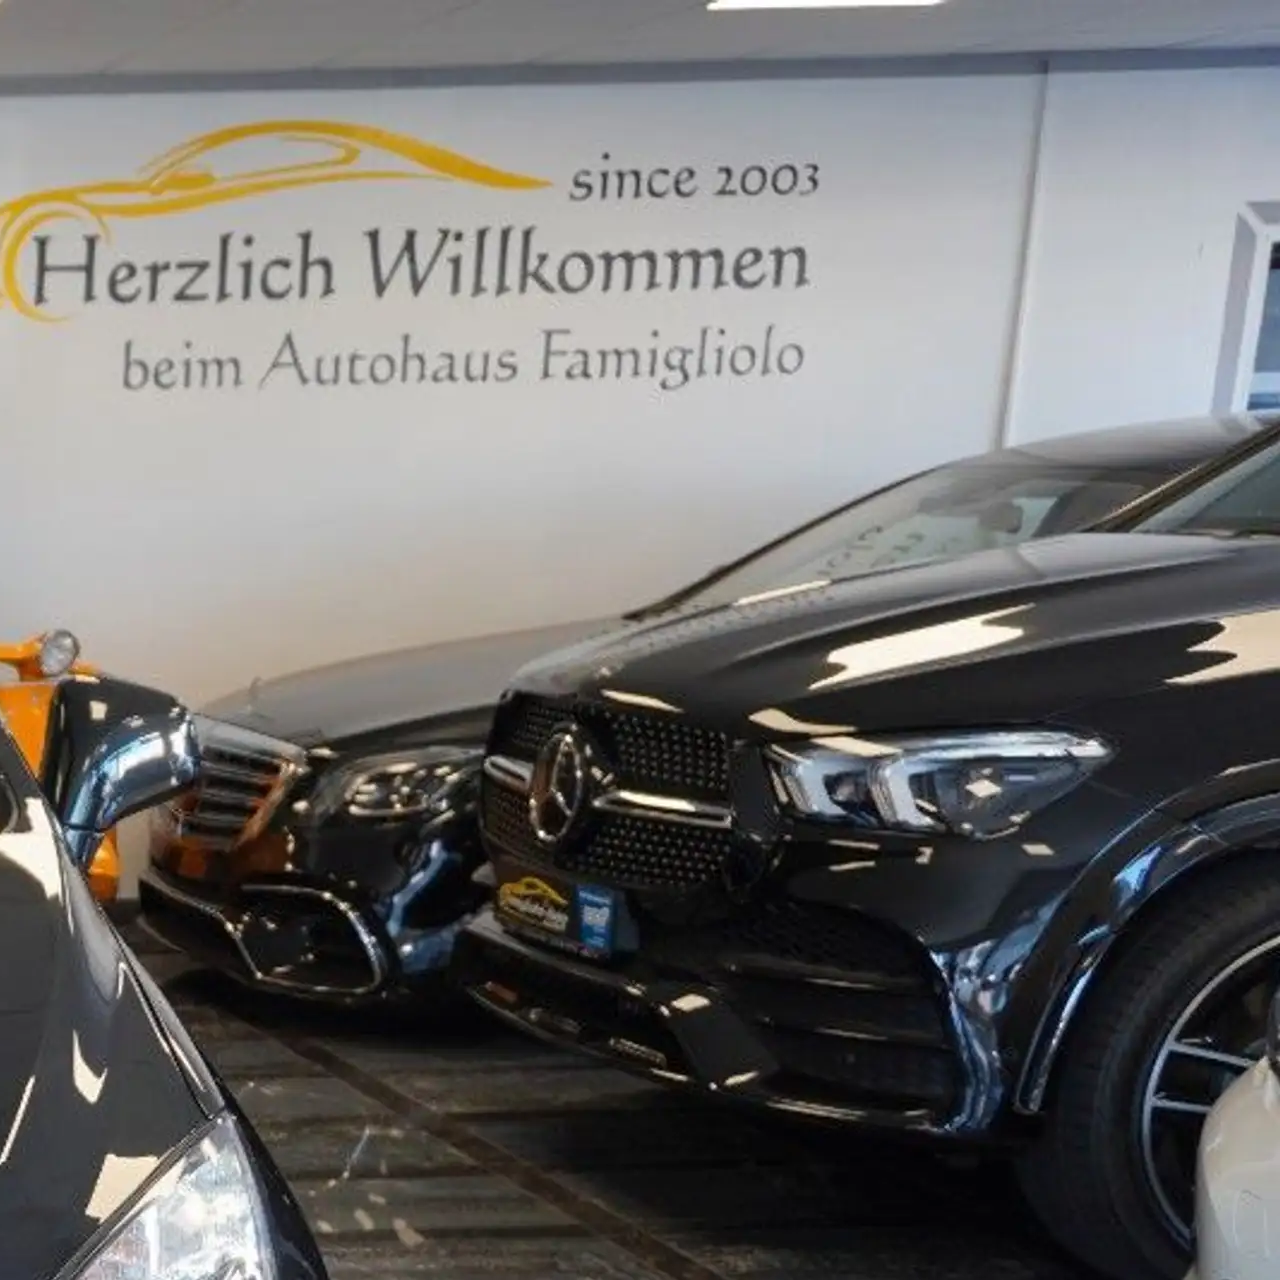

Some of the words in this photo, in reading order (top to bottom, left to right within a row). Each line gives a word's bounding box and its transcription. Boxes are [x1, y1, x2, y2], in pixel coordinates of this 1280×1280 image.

[569, 152, 697, 201] since
[712, 163, 821, 197] 2003
[33, 229, 335, 307] Herzlich
[362, 224, 811, 299] Willkommen
[122, 339, 244, 391] beim
[258, 328, 519, 390] Autohaus
[539, 323, 805, 391] Famigliolo
